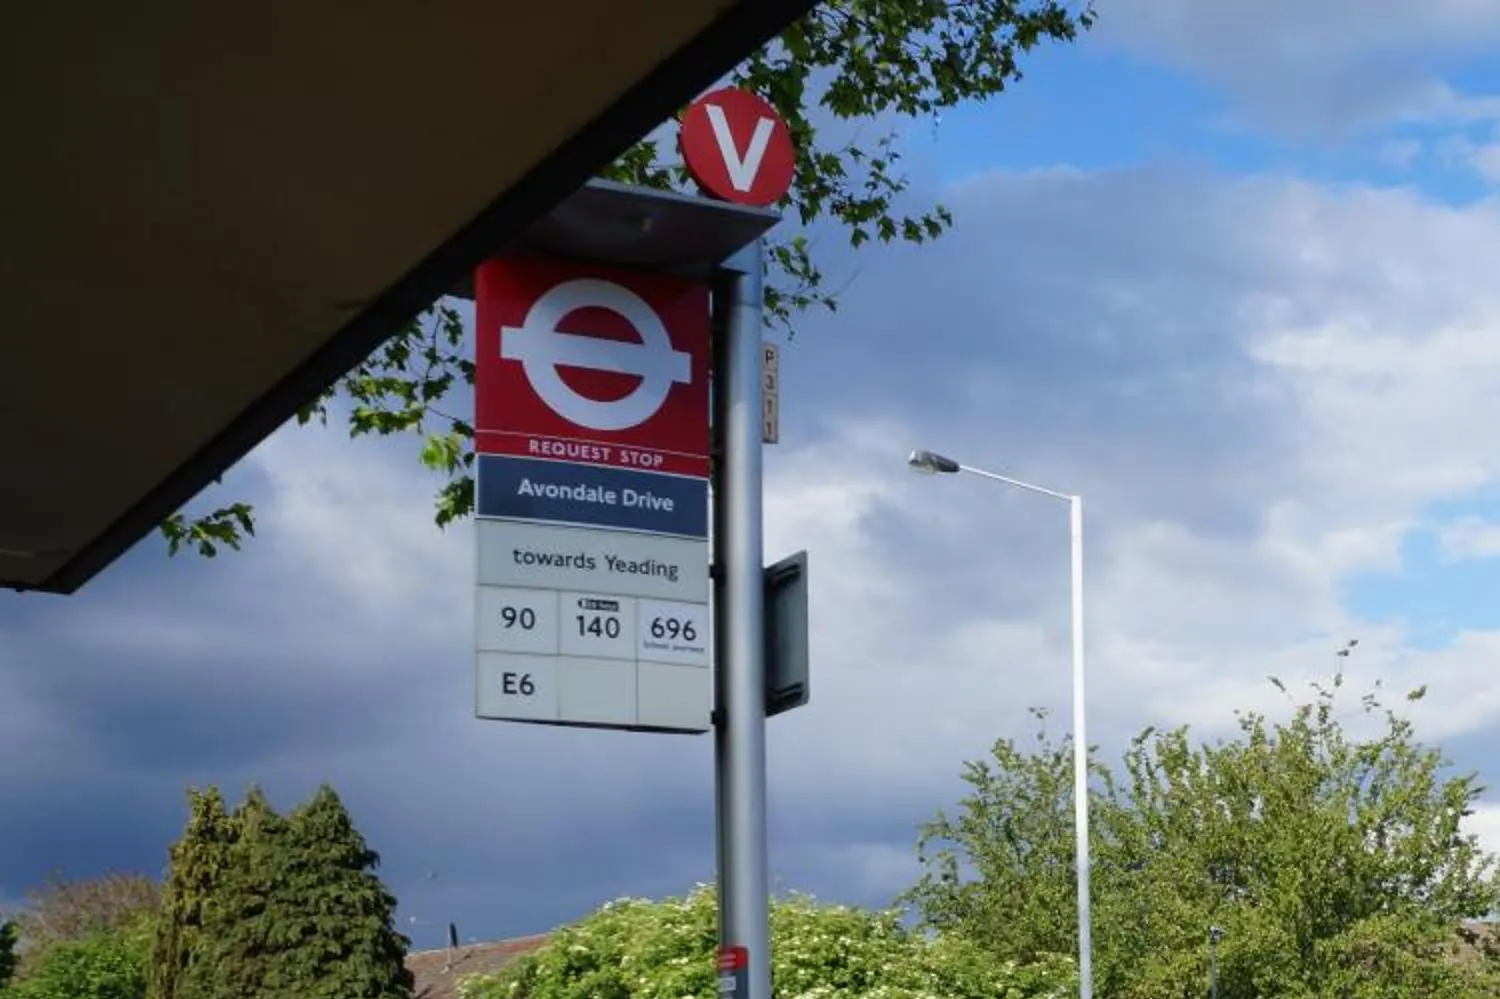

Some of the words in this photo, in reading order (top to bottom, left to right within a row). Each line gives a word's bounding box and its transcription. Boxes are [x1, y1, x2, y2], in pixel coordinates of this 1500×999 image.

[705, 103, 775, 192] V
[529, 439, 611, 461] REQUEST
[620, 450, 664, 468] STOP
[517, 478, 617, 505] Avondale
[622, 489, 675, 512] Drive
[512, 549, 597, 570] towards
[605, 556, 679, 582] Yeading
[501, 607, 536, 631] 90
[576, 615, 621, 639] 140
[650, 617, 697, 641] 696
[502, 672, 535, 696] E6
